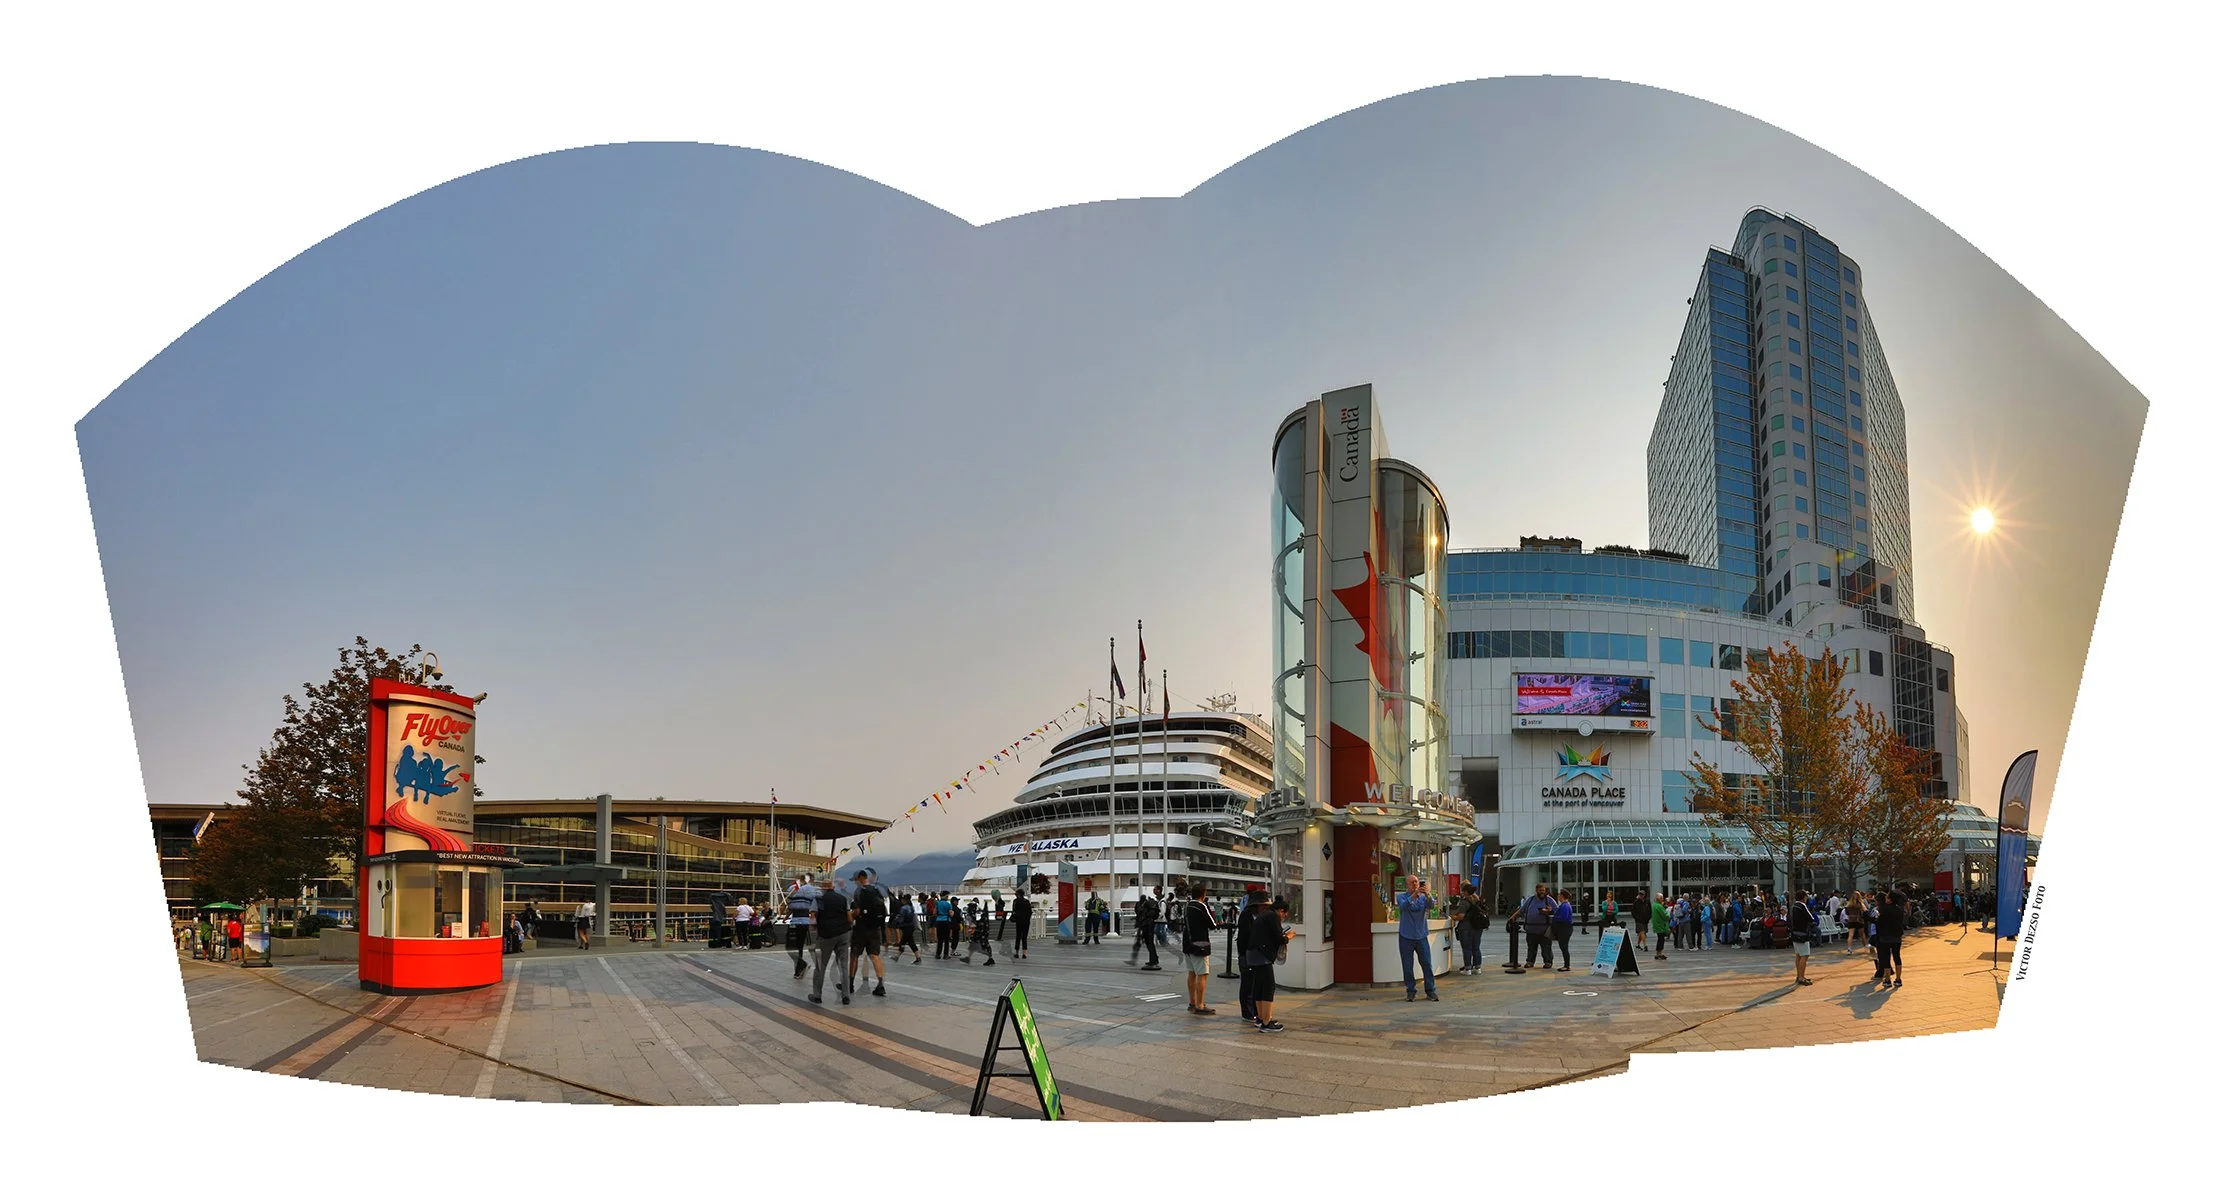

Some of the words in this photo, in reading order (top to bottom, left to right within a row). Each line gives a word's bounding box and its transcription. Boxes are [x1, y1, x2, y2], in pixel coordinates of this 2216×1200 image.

[1340, 405, 1359, 482] Canada
[438, 741, 466, 753] CANADA
[1364, 781, 1463, 814] WELCOME
[1541, 787, 1587, 798] CANADA
[1591, 787, 1626, 798] PLACE
[1543, 799, 1551, 807] at
[1552, 799, 1563, 807] the
[1565, 799, 1580, 808] port
[1581, 799, 1588, 807] of
[469, 843, 505, 855] TICKETS
[1008, 843, 1024, 853] WE
[1031, 839, 1079, 851] ALASKA
